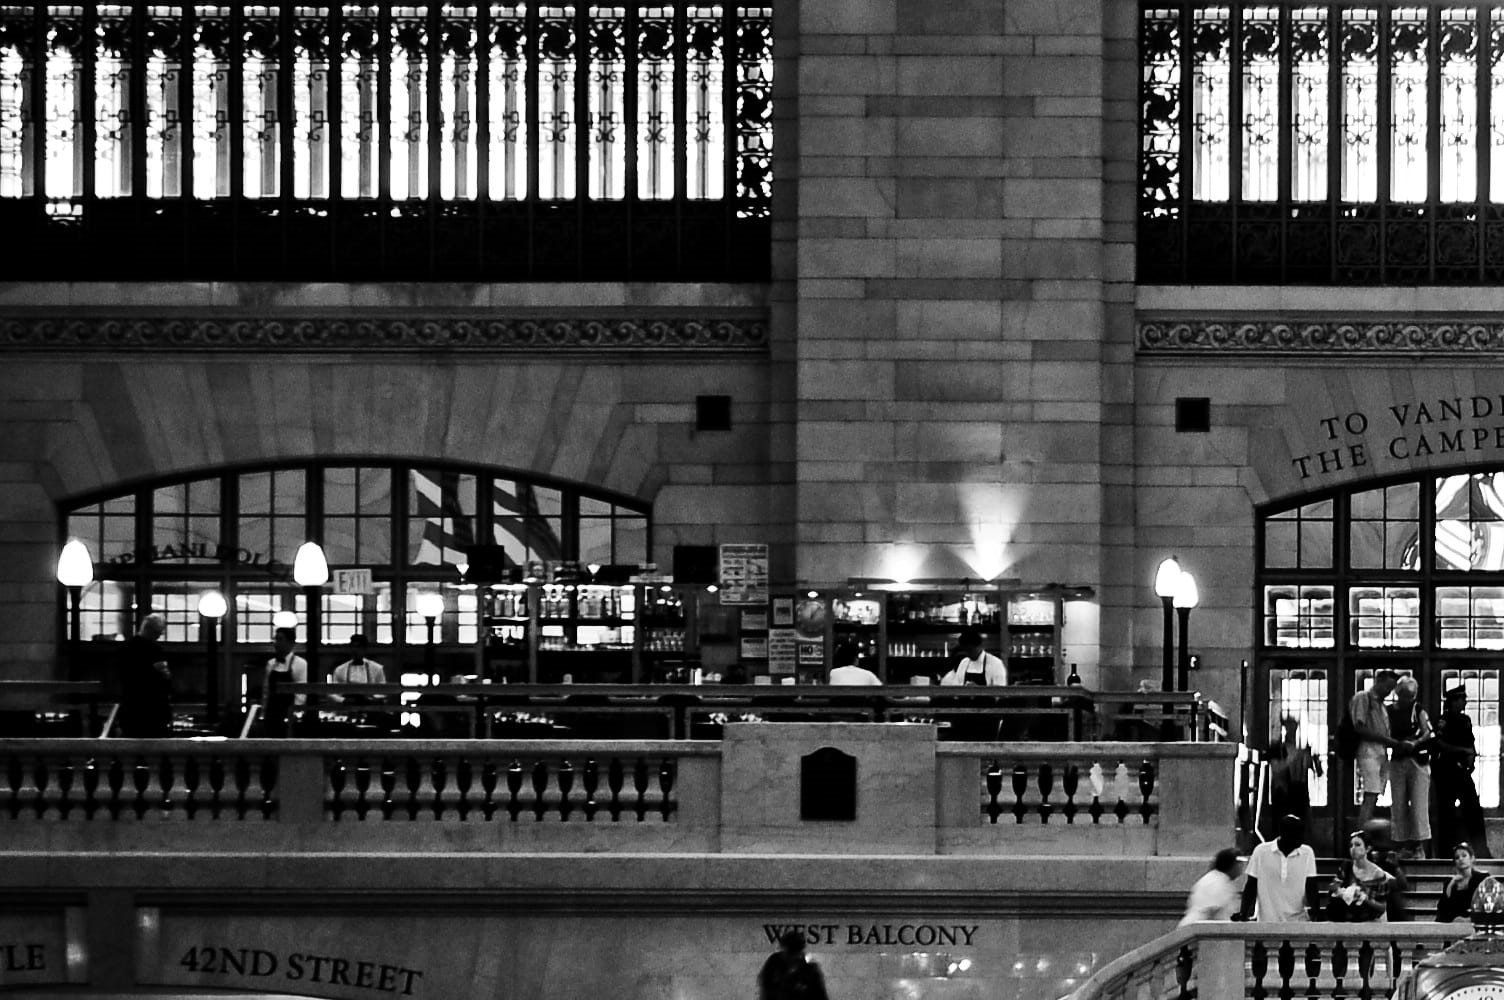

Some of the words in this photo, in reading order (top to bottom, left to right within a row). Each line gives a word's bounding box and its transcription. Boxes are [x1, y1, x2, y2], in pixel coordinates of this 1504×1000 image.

[1320, 412, 1368, 440] TO
[1292, 444, 1367, 479] THE
[339, 571, 367, 592] EXIT
[846, 924, 979, 946] BALCONY
[0, 945, 46, 971] LE
[181, 946, 277, 976] 42ND
[286, 953, 423, 996] STREET
